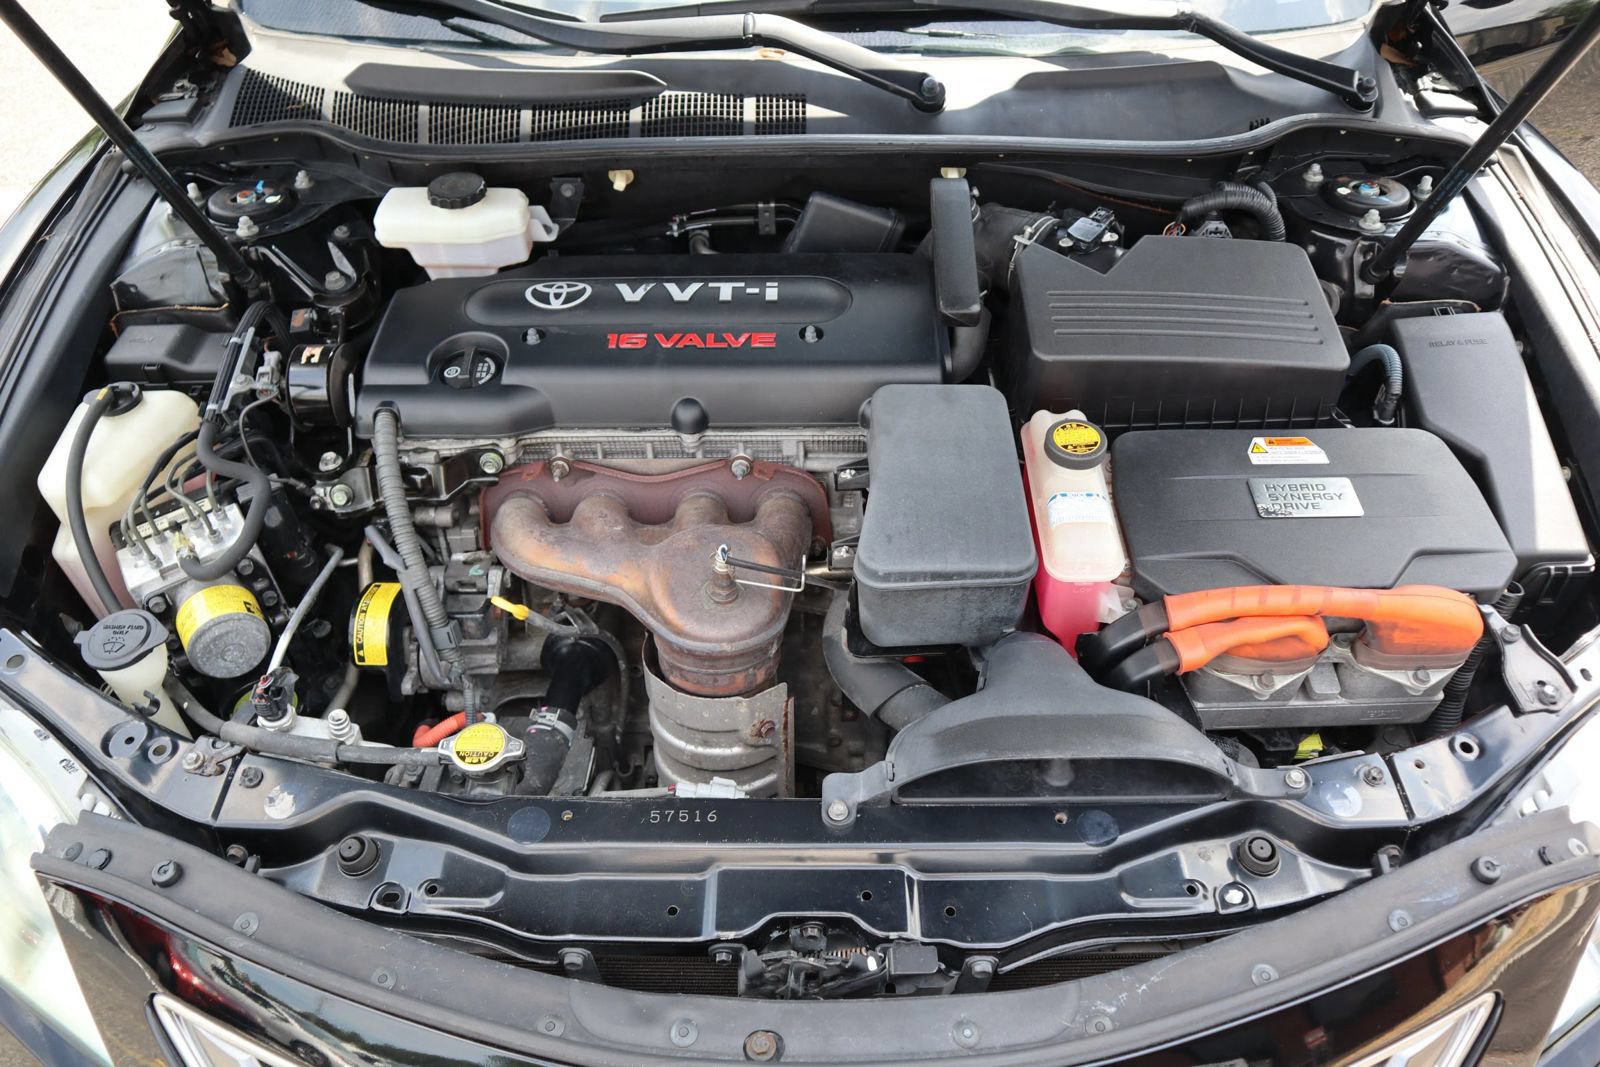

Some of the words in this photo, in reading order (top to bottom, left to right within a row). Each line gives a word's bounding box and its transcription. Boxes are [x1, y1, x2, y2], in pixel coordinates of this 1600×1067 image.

[614, 282, 779, 302] VVT-i
[607, 333, 648, 349] 16
[654, 333, 777, 349] VALVE
[1428, 339, 1455, 348] RELAY
[1464, 338, 1489, 346] FUSE
[1265, 483, 1326, 492] HYBRID
[1268, 492, 1344, 501] SYNERGY
[1272, 502, 1322, 510] DRIVE
[356, 612, 366, 644] CAUTION
[649, 810, 718, 824] 57516
